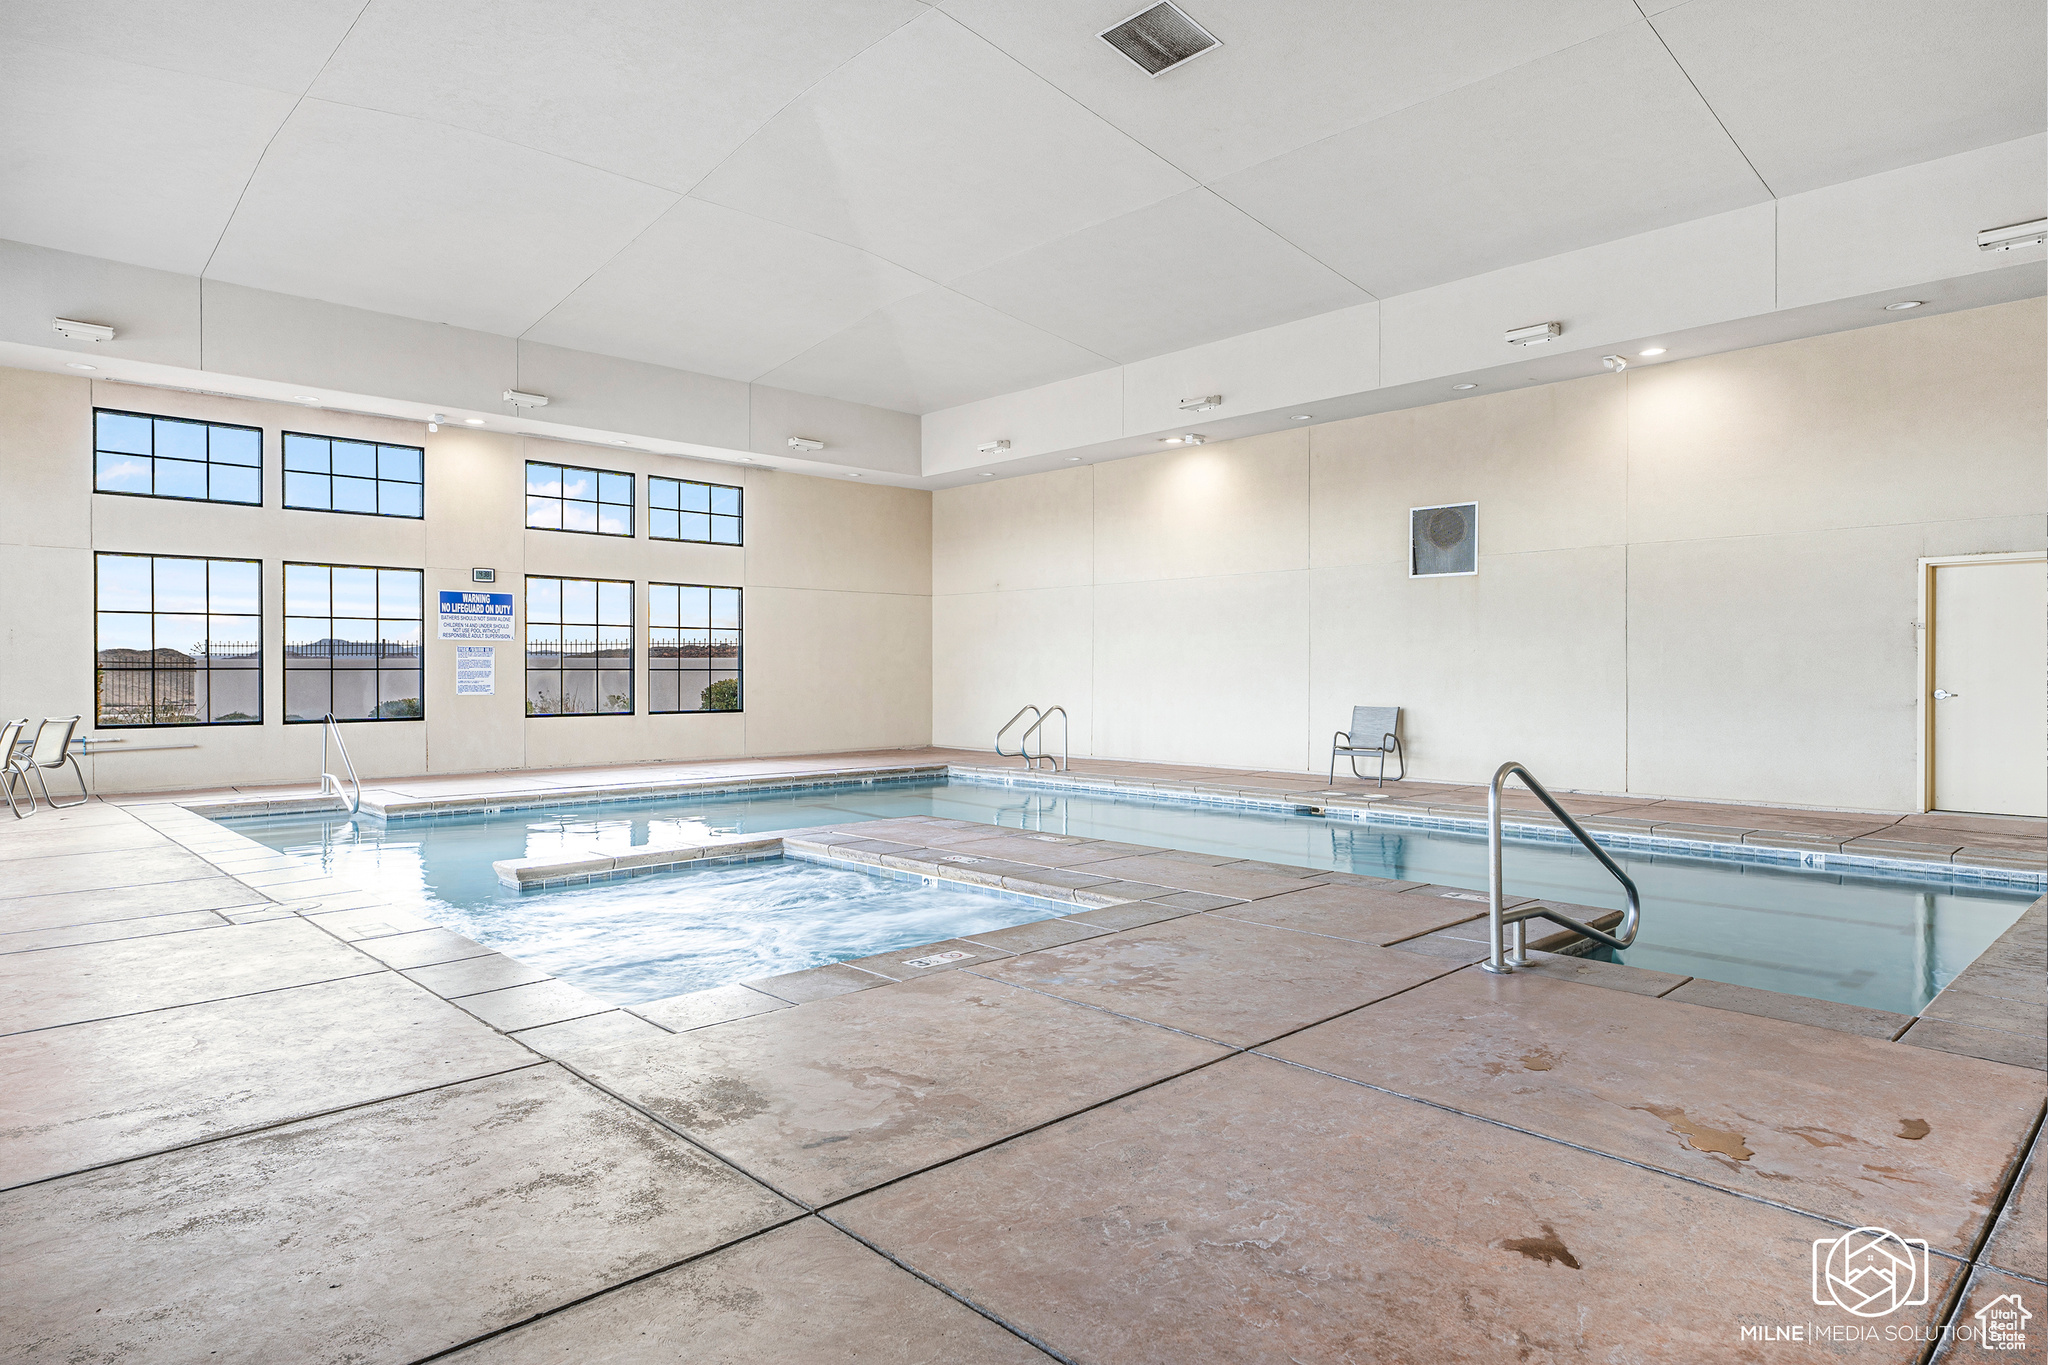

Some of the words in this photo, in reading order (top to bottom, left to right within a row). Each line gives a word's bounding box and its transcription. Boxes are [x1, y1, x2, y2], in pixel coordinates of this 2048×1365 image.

[462, 594, 490, 604] WARNING
[442, 602, 450, 612] NO
[452, 603, 484, 614] LIFEGUARD
[485, 604, 494, 614] ON
[495, 605, 511, 614] DUTY
